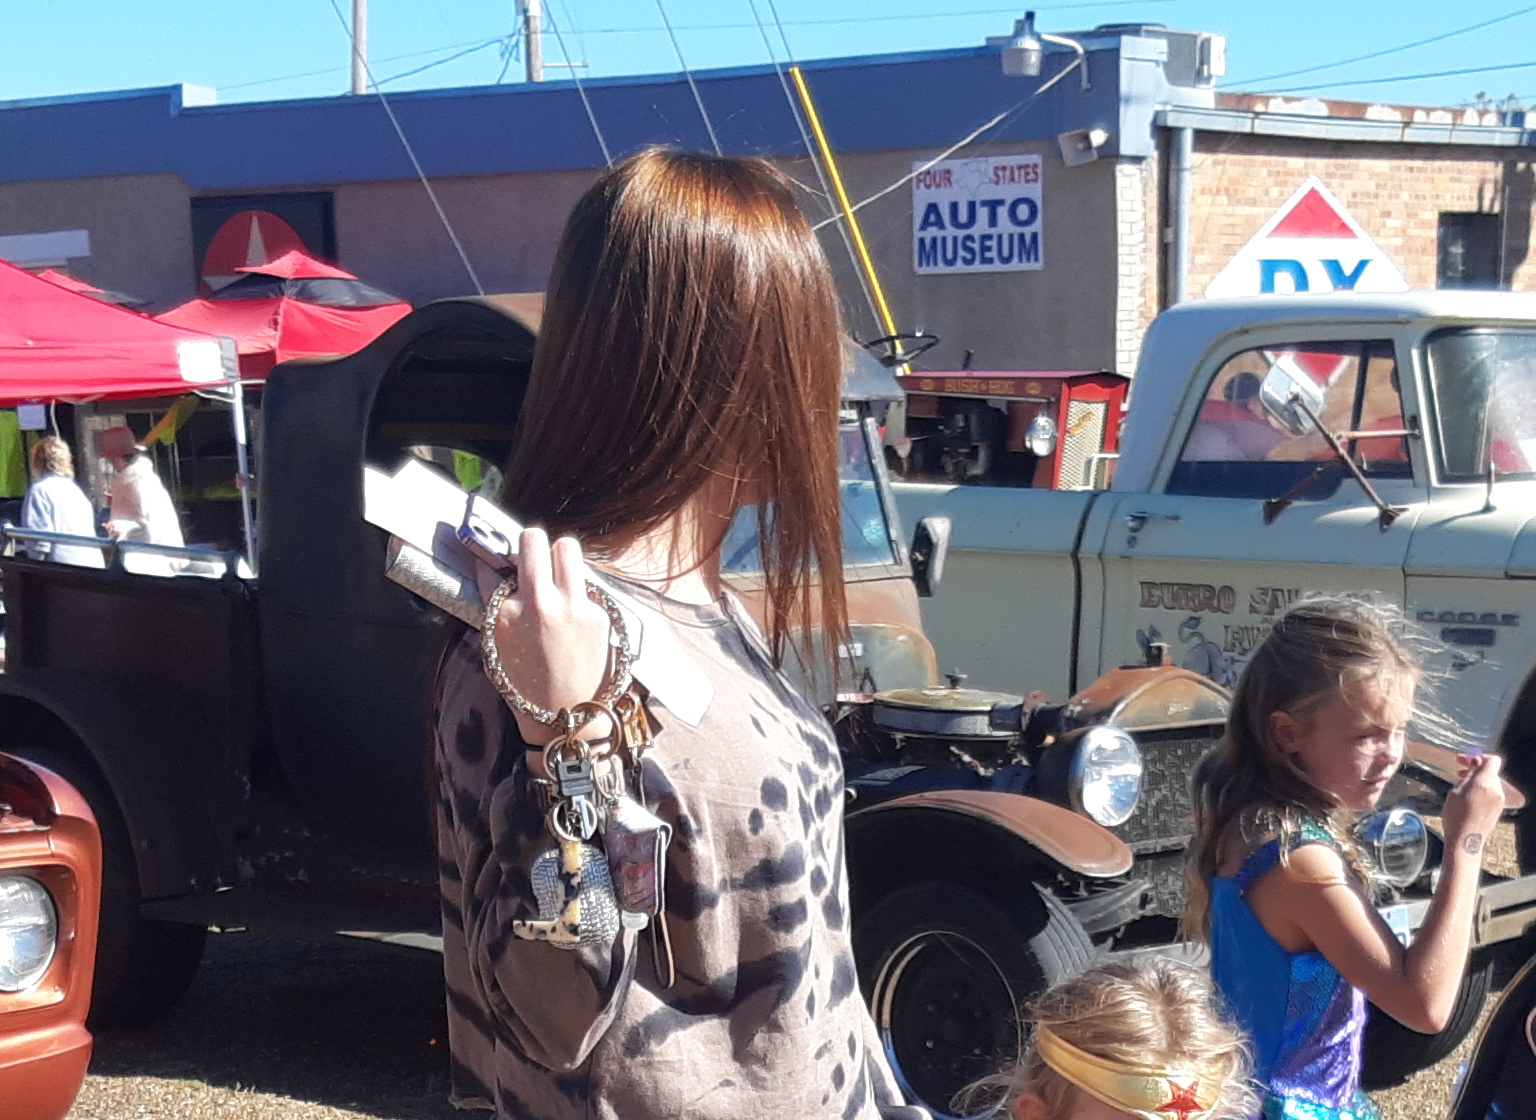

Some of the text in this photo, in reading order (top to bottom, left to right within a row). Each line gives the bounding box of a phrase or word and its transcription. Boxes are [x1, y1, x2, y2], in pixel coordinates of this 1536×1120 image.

[915, 163, 1040, 190] FOUR STATES
[917, 196, 1039, 232] AUTO
[917, 231, 1040, 268] MUSEUM
